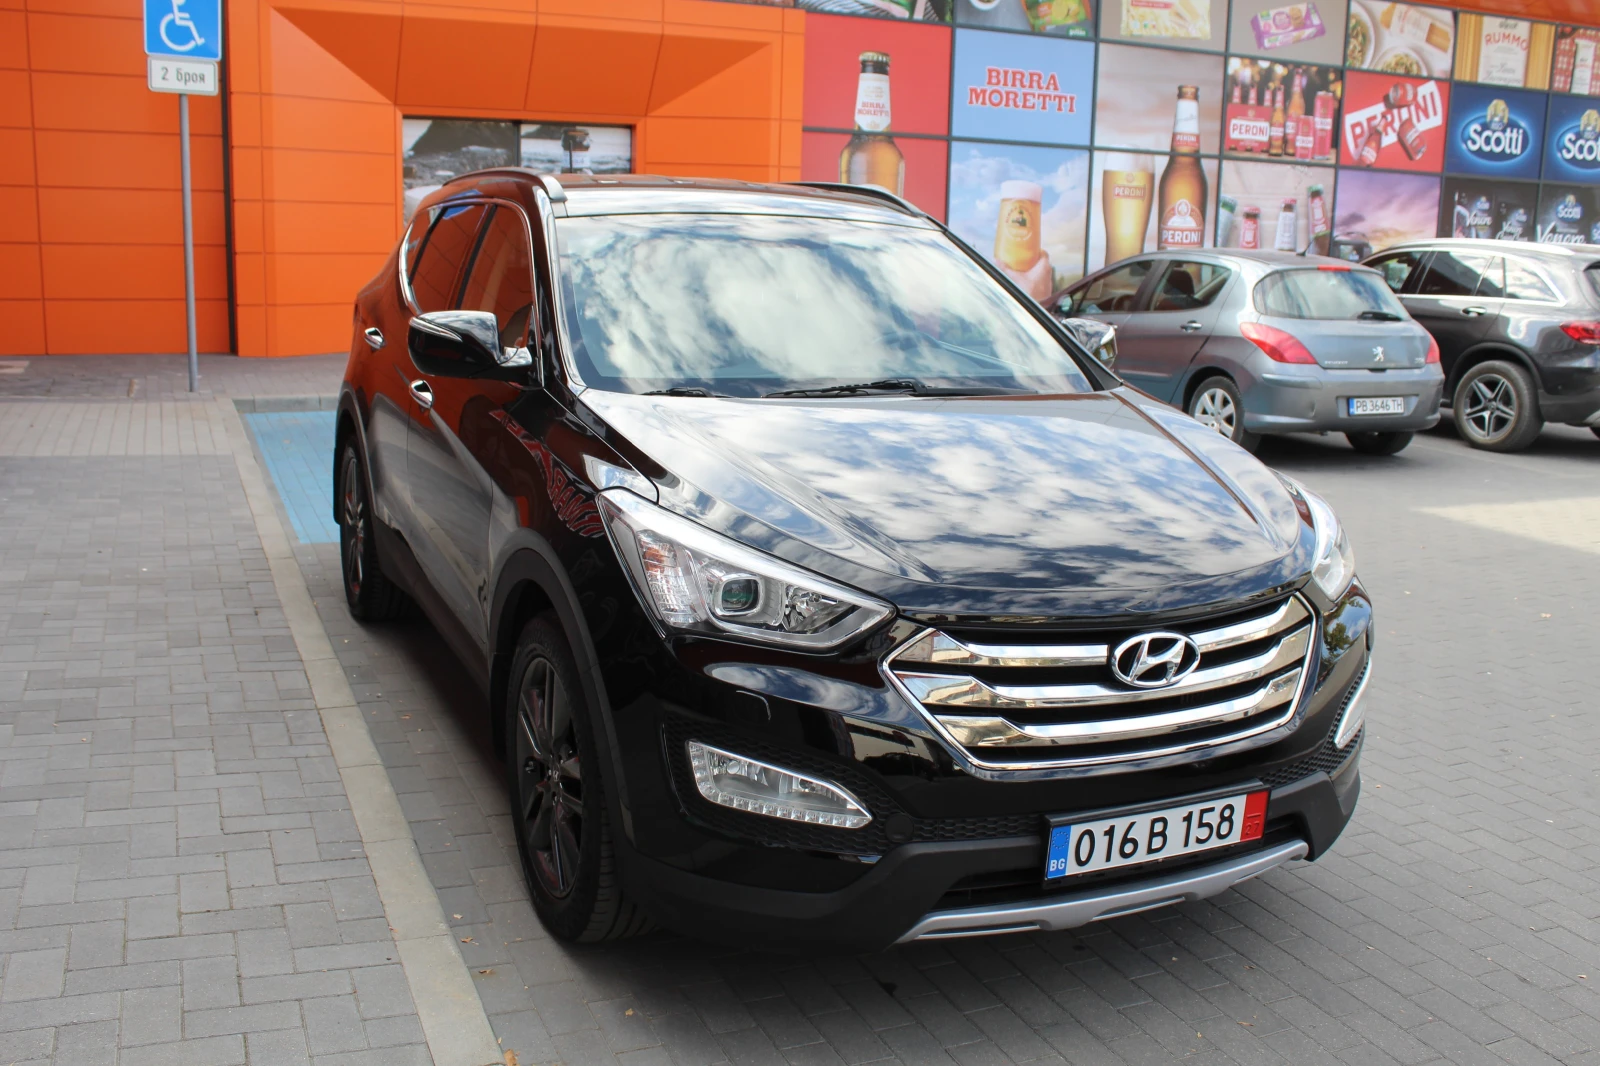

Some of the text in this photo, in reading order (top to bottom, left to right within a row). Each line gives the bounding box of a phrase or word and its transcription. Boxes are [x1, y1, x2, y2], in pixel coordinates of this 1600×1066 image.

[1484, 32, 1529, 52] RUMMO
[161, 66, 206, 85] 2 броя
[986, 67, 1060, 92] BIRRA
[967, 86, 1076, 113] MORETTI
[1232, 123, 1268, 137] PERONI
[1467, 123, 1523, 155] Scotti
[1114, 186, 1144, 197] PERONI
[1162, 230, 1201, 243] PERONI
[1355, 399, 1403, 412] PB 3646 TH
[1181, 803, 1235, 847] 158
[1049, 857, 1066, 872] BG
